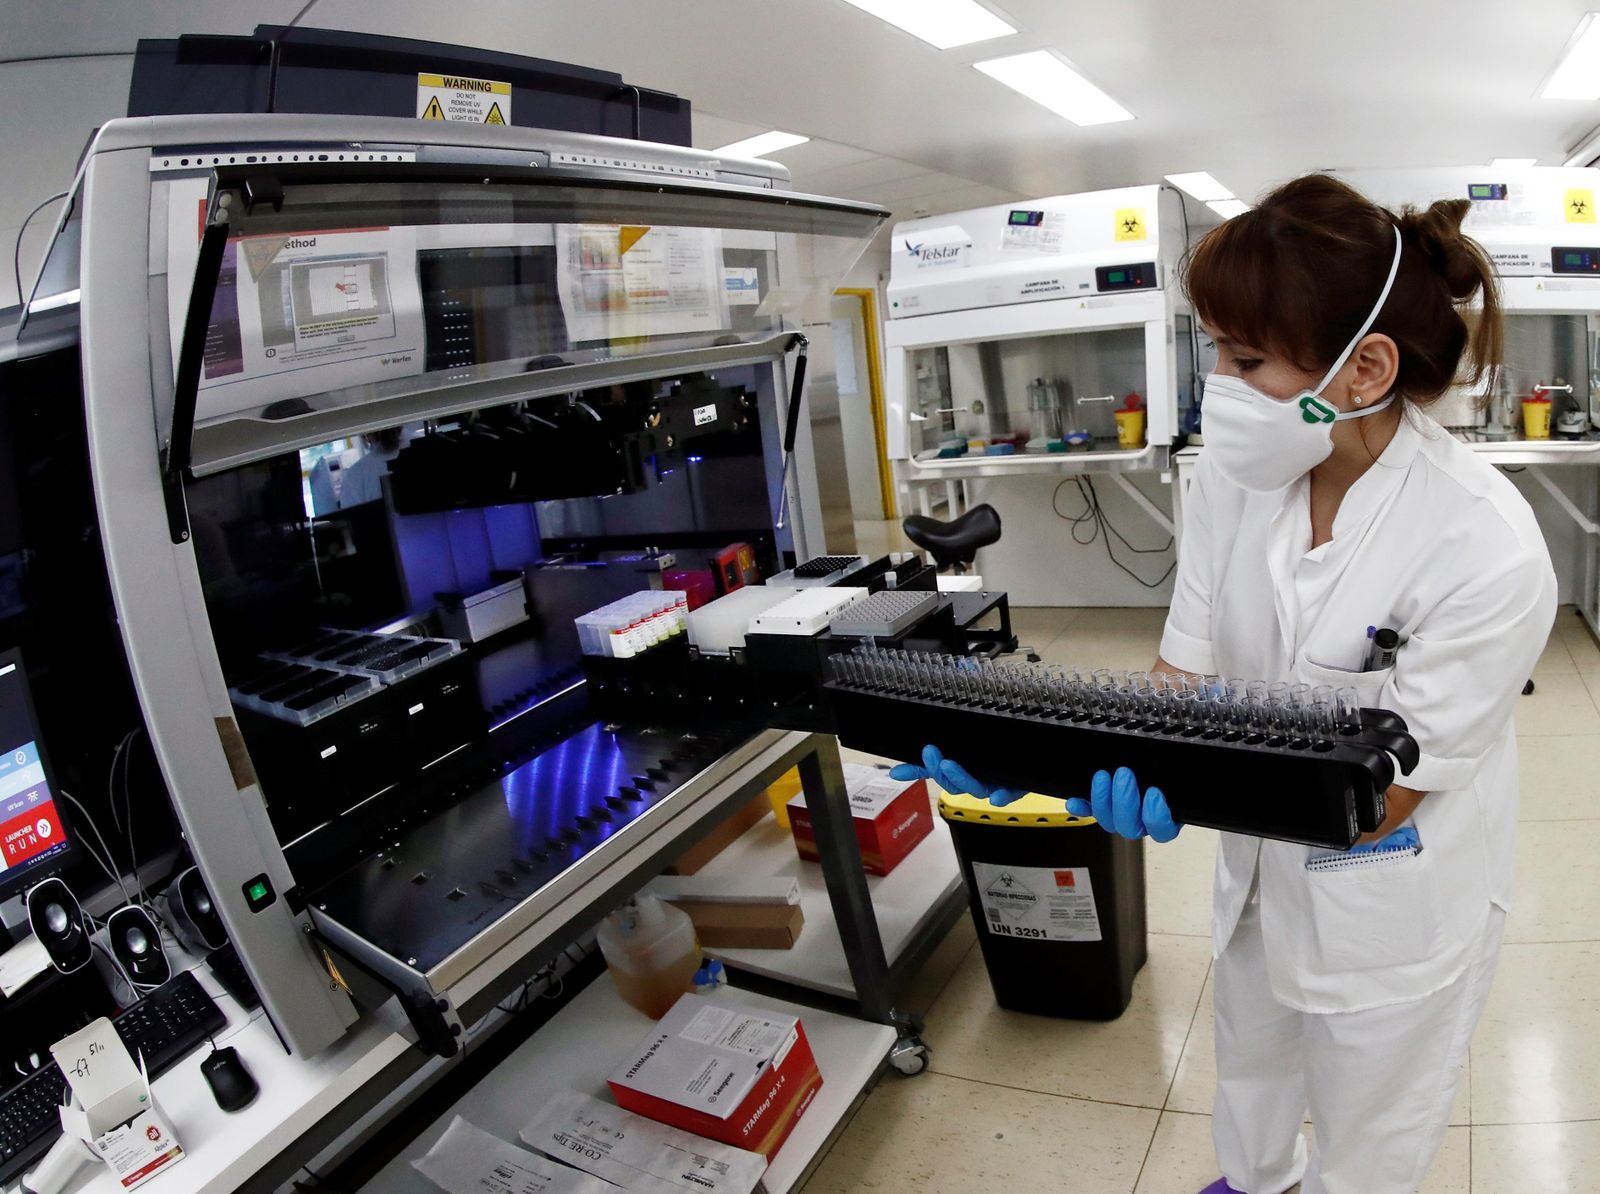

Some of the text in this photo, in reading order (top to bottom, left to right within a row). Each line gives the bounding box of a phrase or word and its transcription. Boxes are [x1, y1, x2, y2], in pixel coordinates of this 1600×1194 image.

[443, 77, 492, 92] WARNING
[451, 99, 473, 107] REMOVE
[285, 237, 317, 250] ethod
[921, 246, 961, 261] Telstar
[1025, 279, 1052, 288] CAMPANA
[5, 825, 33, 843] LAUNCHER
[992, 924, 1048, 938] UN 3291
[626, 1048, 654, 1079] STARMag
[650, 1040, 661, 1052] 96
[713, 1072, 735, 1097] Seegene
[742, 1075, 786, 1136] STARMag 96 X 4
[552, 1133, 572, 1149] Tips
[572, 1143, 602, 1161] CO-RE
